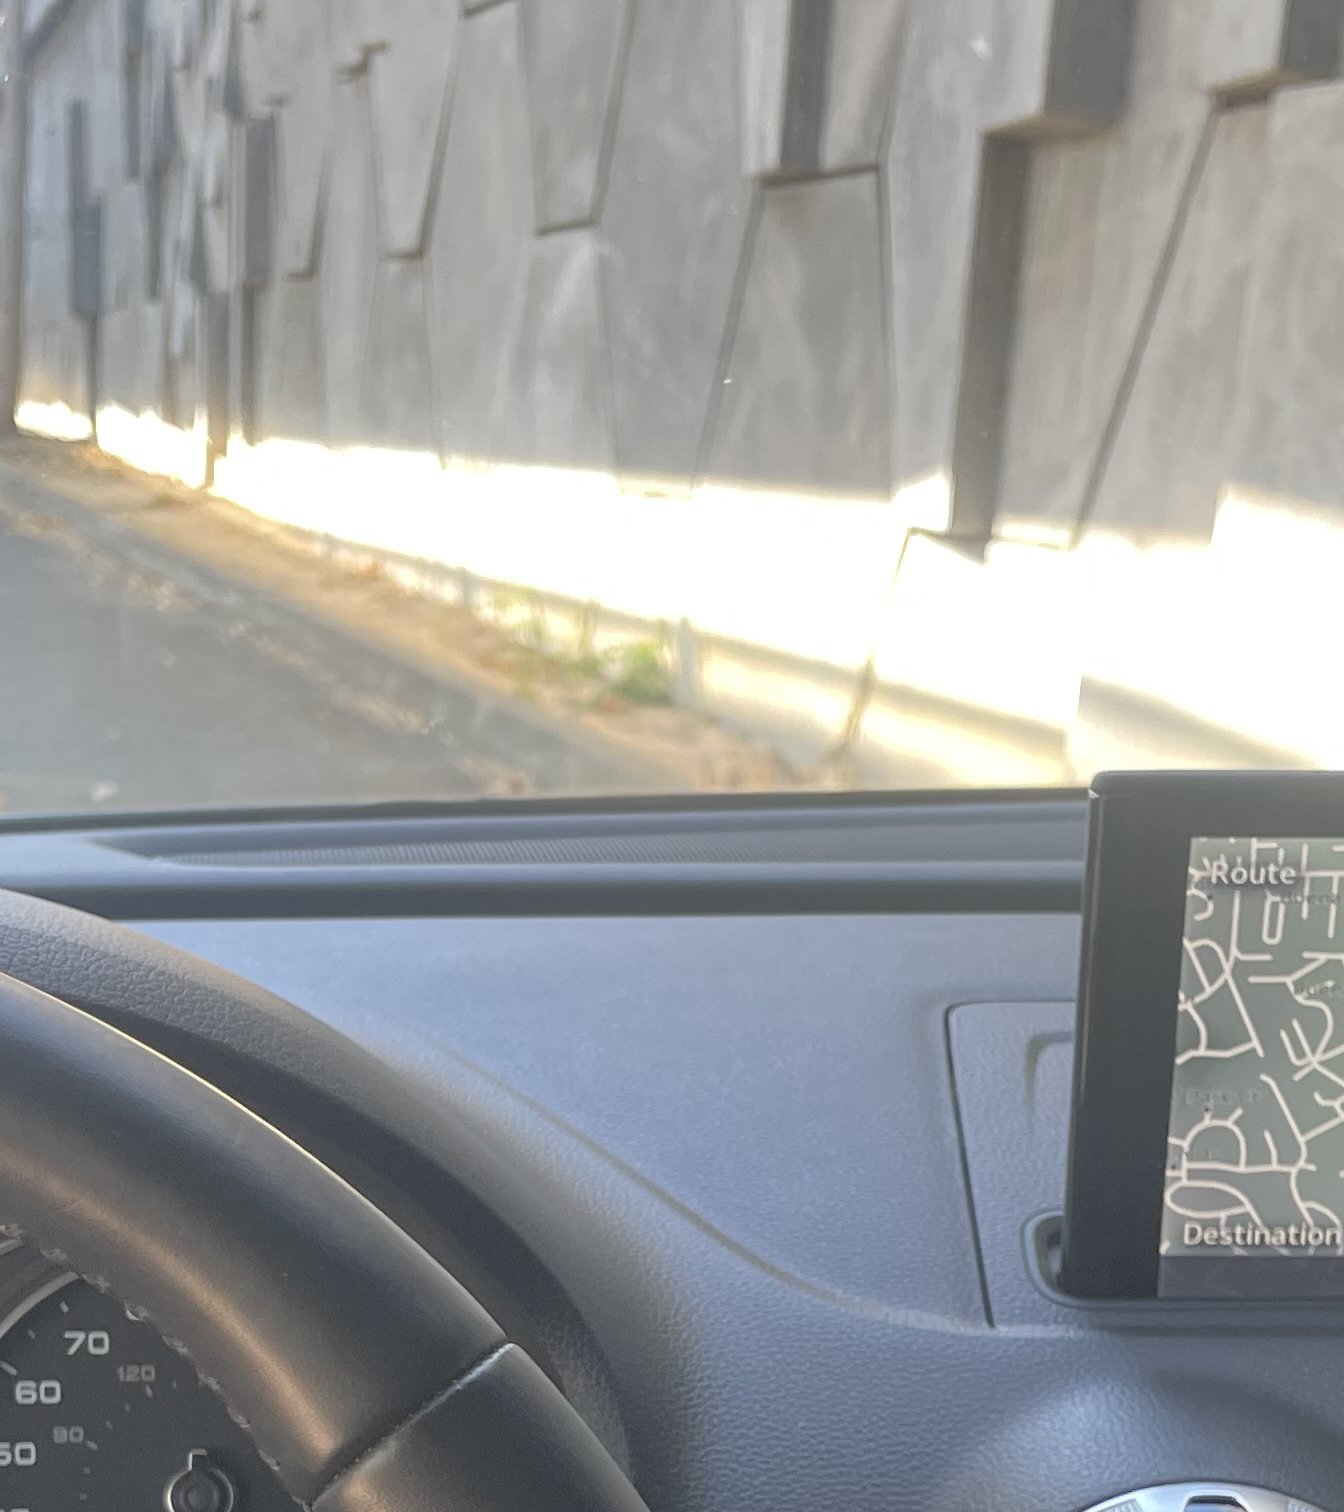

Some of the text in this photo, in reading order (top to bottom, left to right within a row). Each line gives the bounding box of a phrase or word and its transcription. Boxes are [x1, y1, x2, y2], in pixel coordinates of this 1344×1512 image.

[1209, 861, 1296, 887] Route
[1183, 1221, 1342, 1247] Destination
[64, 1330, 110, 1355] 70
[116, 1364, 156, 1383] 120
[14, 1380, 62, 1405] 60
